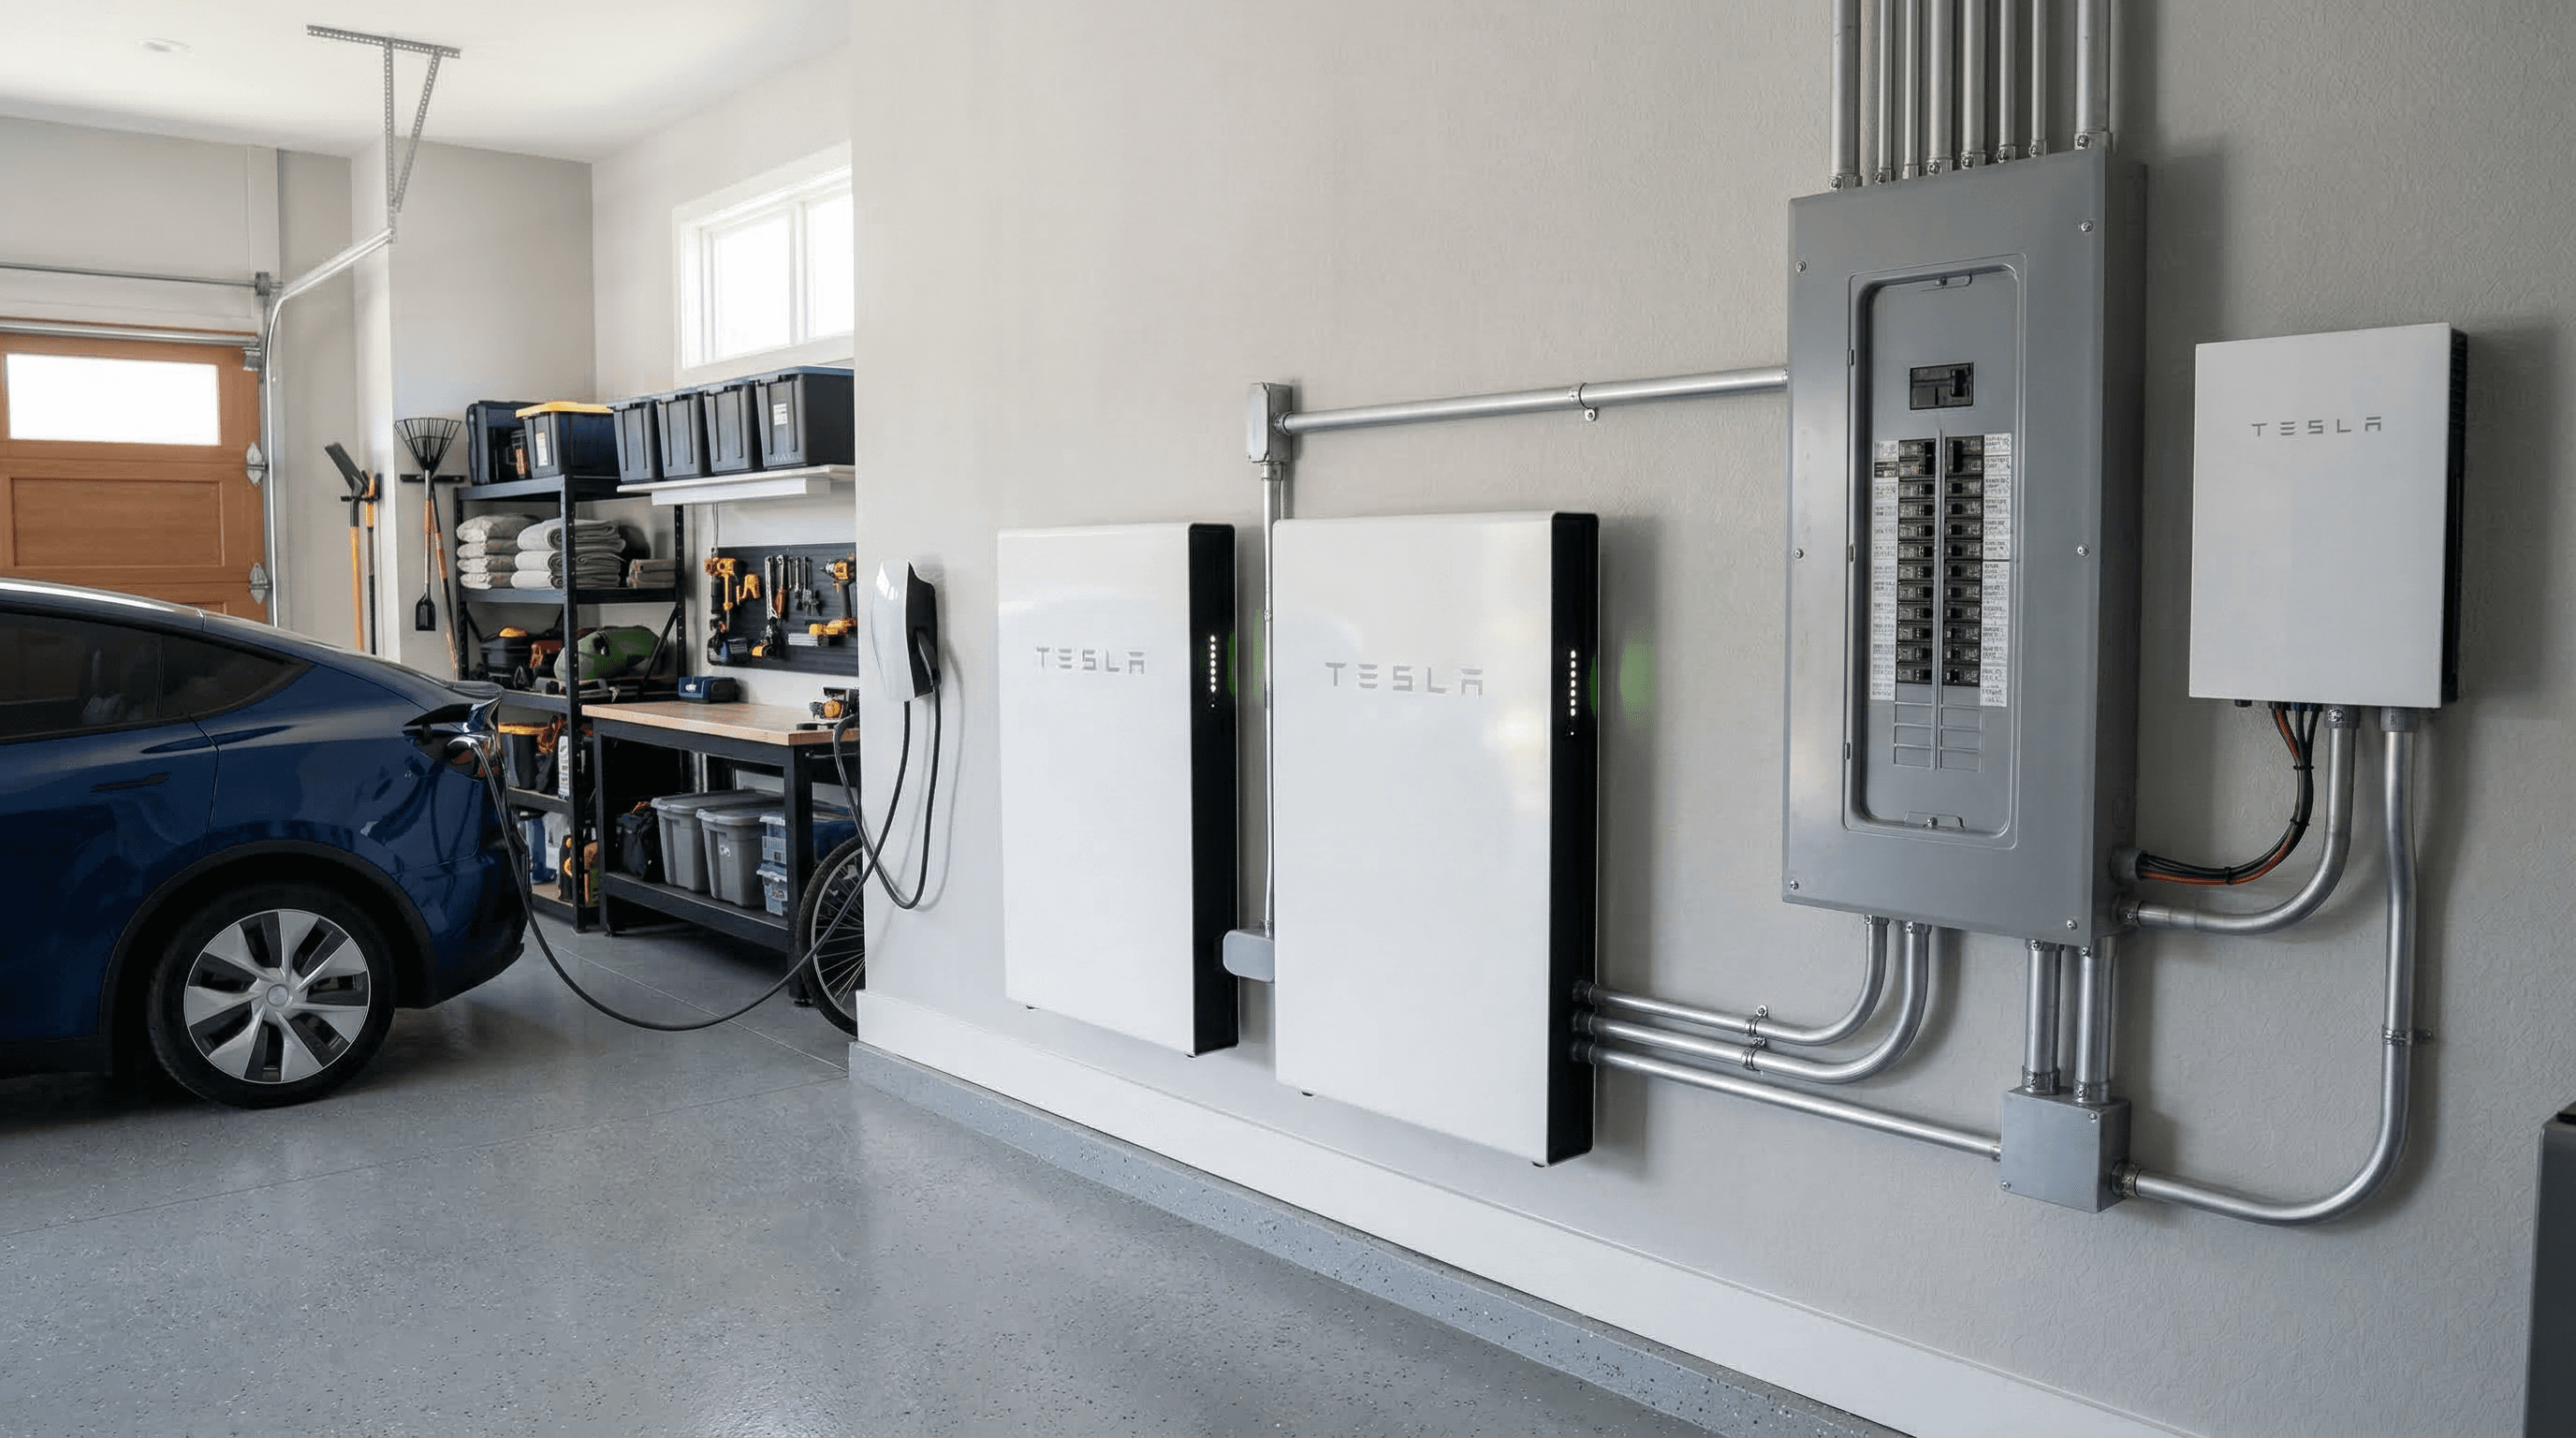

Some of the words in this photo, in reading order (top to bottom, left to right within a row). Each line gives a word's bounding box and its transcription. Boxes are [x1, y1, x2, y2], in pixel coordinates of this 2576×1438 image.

[2250, 417, 2382, 437] TESLA
[1036, 647, 1145, 674] TESLA
[1325, 662, 1483, 697] TESLA
